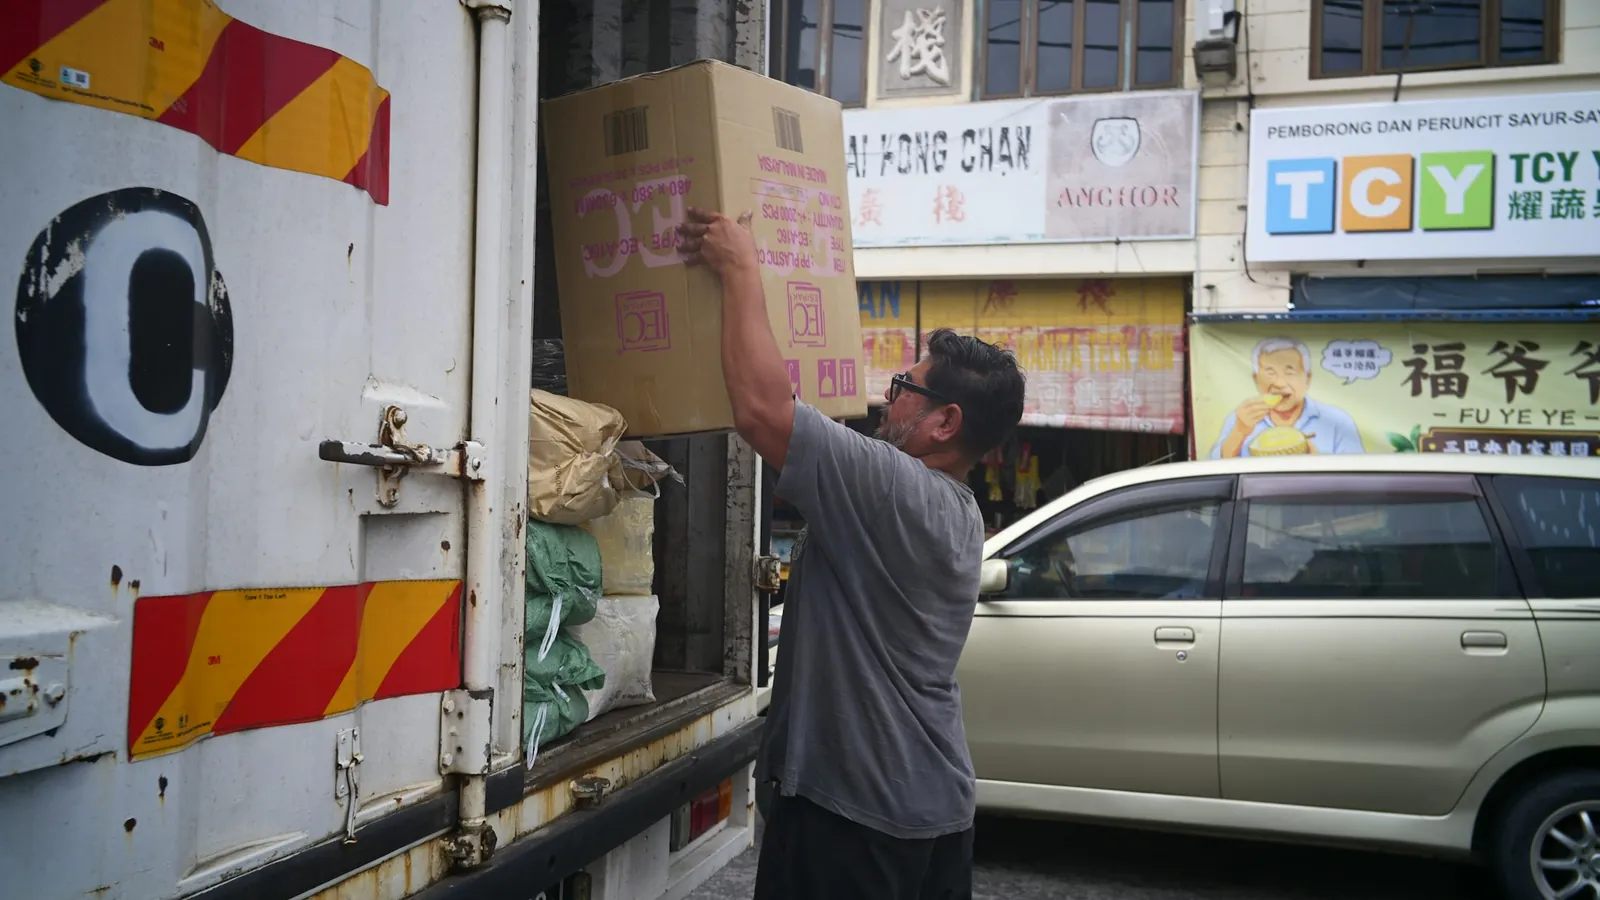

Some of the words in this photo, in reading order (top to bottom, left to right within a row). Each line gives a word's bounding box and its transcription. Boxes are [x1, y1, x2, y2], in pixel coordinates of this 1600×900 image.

[148, 36, 165, 51] 3M
[1267, 121, 1373, 140] PEMBORONG
[1378, 117, 1413, 134] DAN
[1418, 114, 1503, 132] PERUNCIT
[961, 125, 1032, 174] CHAN
[757, 154, 797, 178] MALAYSIA
[1509, 151, 1580, 184] TCY
[1275, 163, 1486, 221] TCY
[762, 204, 779, 220] PCS
[812, 211, 843, 231] QUANTITY
[651, 230, 681, 251] YPE
[766, 250, 799, 267] PLASTIC
[623, 309, 661, 344] EC
[794, 303, 820, 337] EC
[1459, 408, 1491, 425] FU
[1500, 408, 1533, 425] YE
[1541, 409, 1576, 427] YE
[207, 655, 221, 665] 3M
